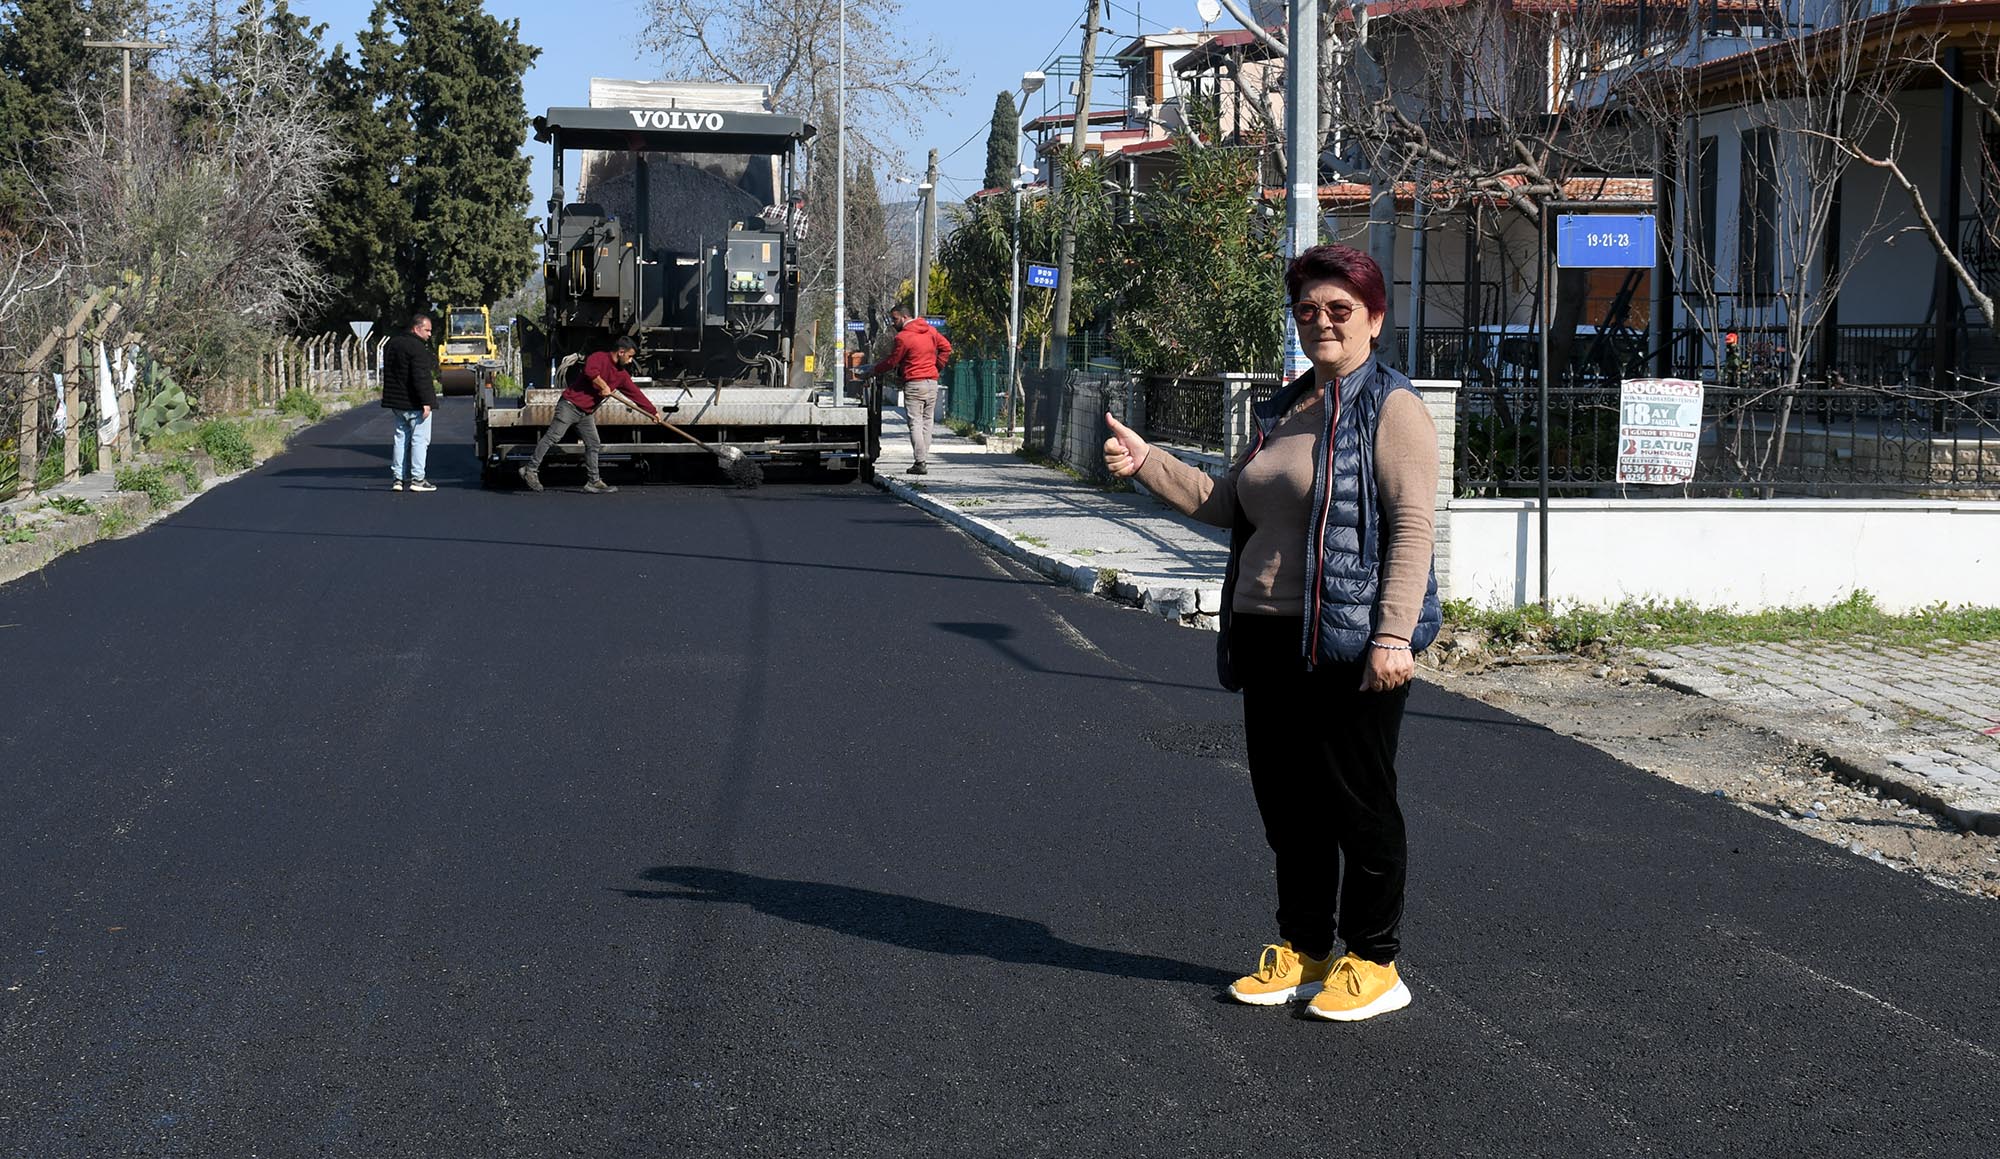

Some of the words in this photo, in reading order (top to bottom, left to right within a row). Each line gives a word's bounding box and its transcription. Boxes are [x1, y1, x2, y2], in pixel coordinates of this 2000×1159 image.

[629, 110, 724, 130] VOLVO
[1623, 380, 1699, 396] DOĞALGAZ
[1624, 403, 1650, 424] 18
[1652, 408, 1669, 418] AY
[1640, 440, 1693, 451] BATUR
